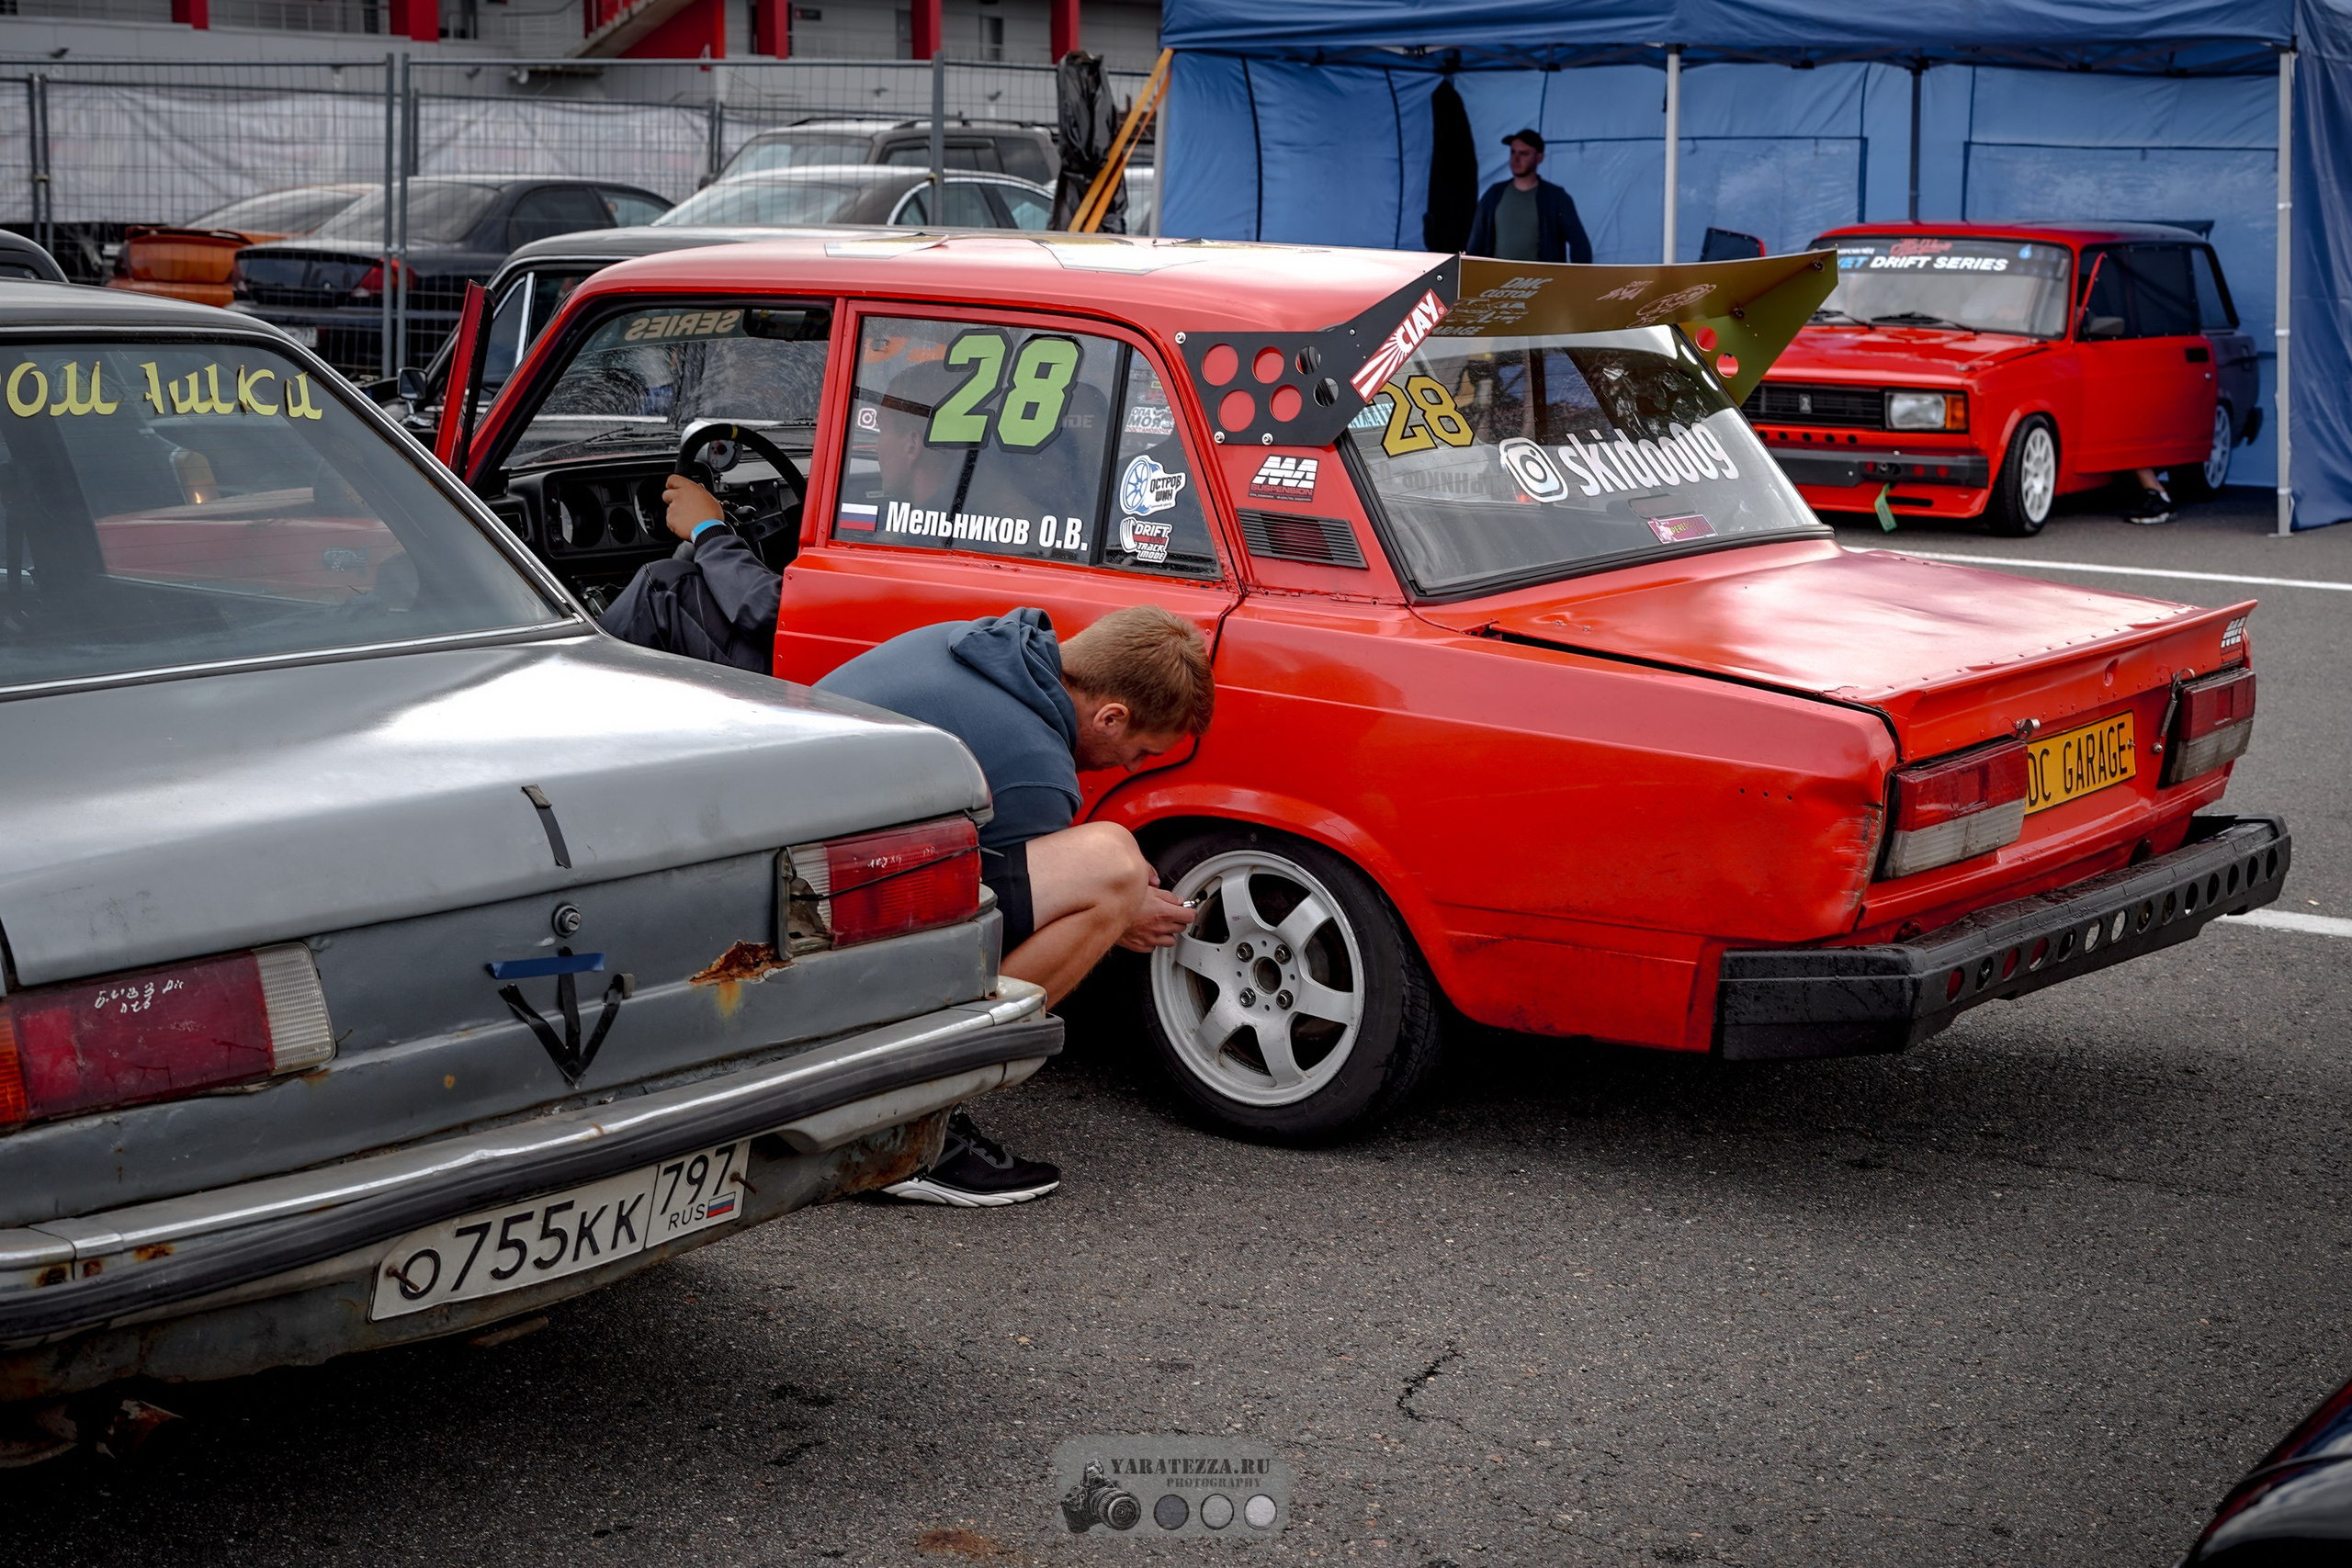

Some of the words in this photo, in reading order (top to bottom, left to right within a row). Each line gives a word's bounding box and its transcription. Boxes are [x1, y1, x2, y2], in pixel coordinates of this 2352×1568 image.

[1870, 256, 1931, 270] DRIFT
[1932, 256, 2009, 272] SERIES
[1430, 326, 1485, 336] ARAGE
[924, 330, 1083, 452] 28
[1127, 416, 1162, 428] МОЯ
[1370, 376, 1475, 457] 28
[1149, 475, 1182, 493] ОСТРОВ
[1250, 484, 1314, 496] SUSPENSION
[1155, 489, 1173, 502] ШИН
[885, 501, 1031, 545] Мельников
[1038, 515, 1089, 551] О.В.
[1134, 523, 1170, 537] DRIFT
[2063, 722, 2128, 795] GARAGE
[660, 1147, 736, 1216] 797
[667, 1204, 706, 1232] RUS
